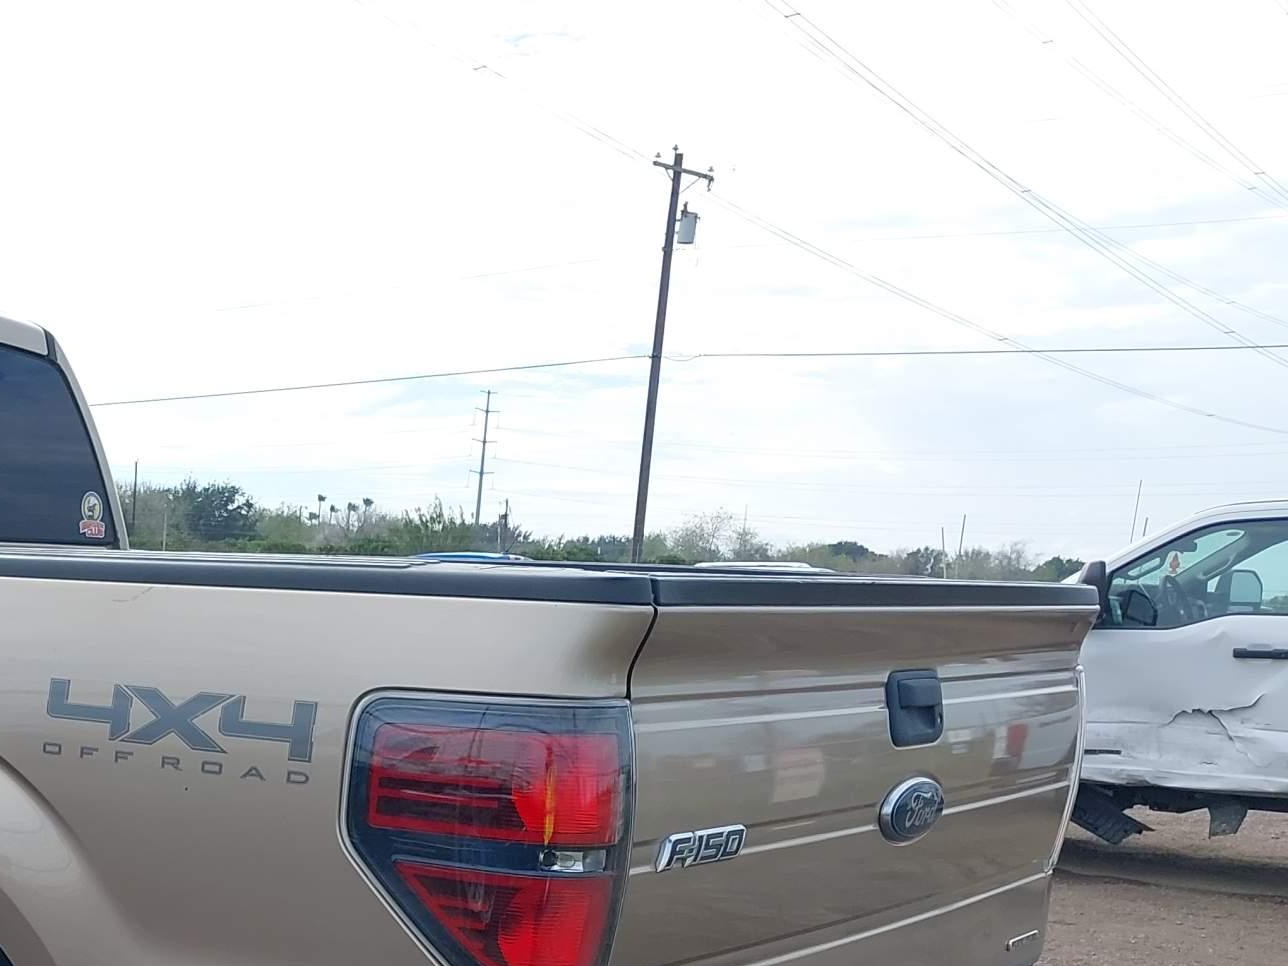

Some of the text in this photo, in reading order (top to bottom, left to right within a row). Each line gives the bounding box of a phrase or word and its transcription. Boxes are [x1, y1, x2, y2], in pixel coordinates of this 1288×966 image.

[42, 741, 310, 785] OFF ROAD
[905, 791, 937, 828] Ford
[658, 825, 746, 871] F-150
